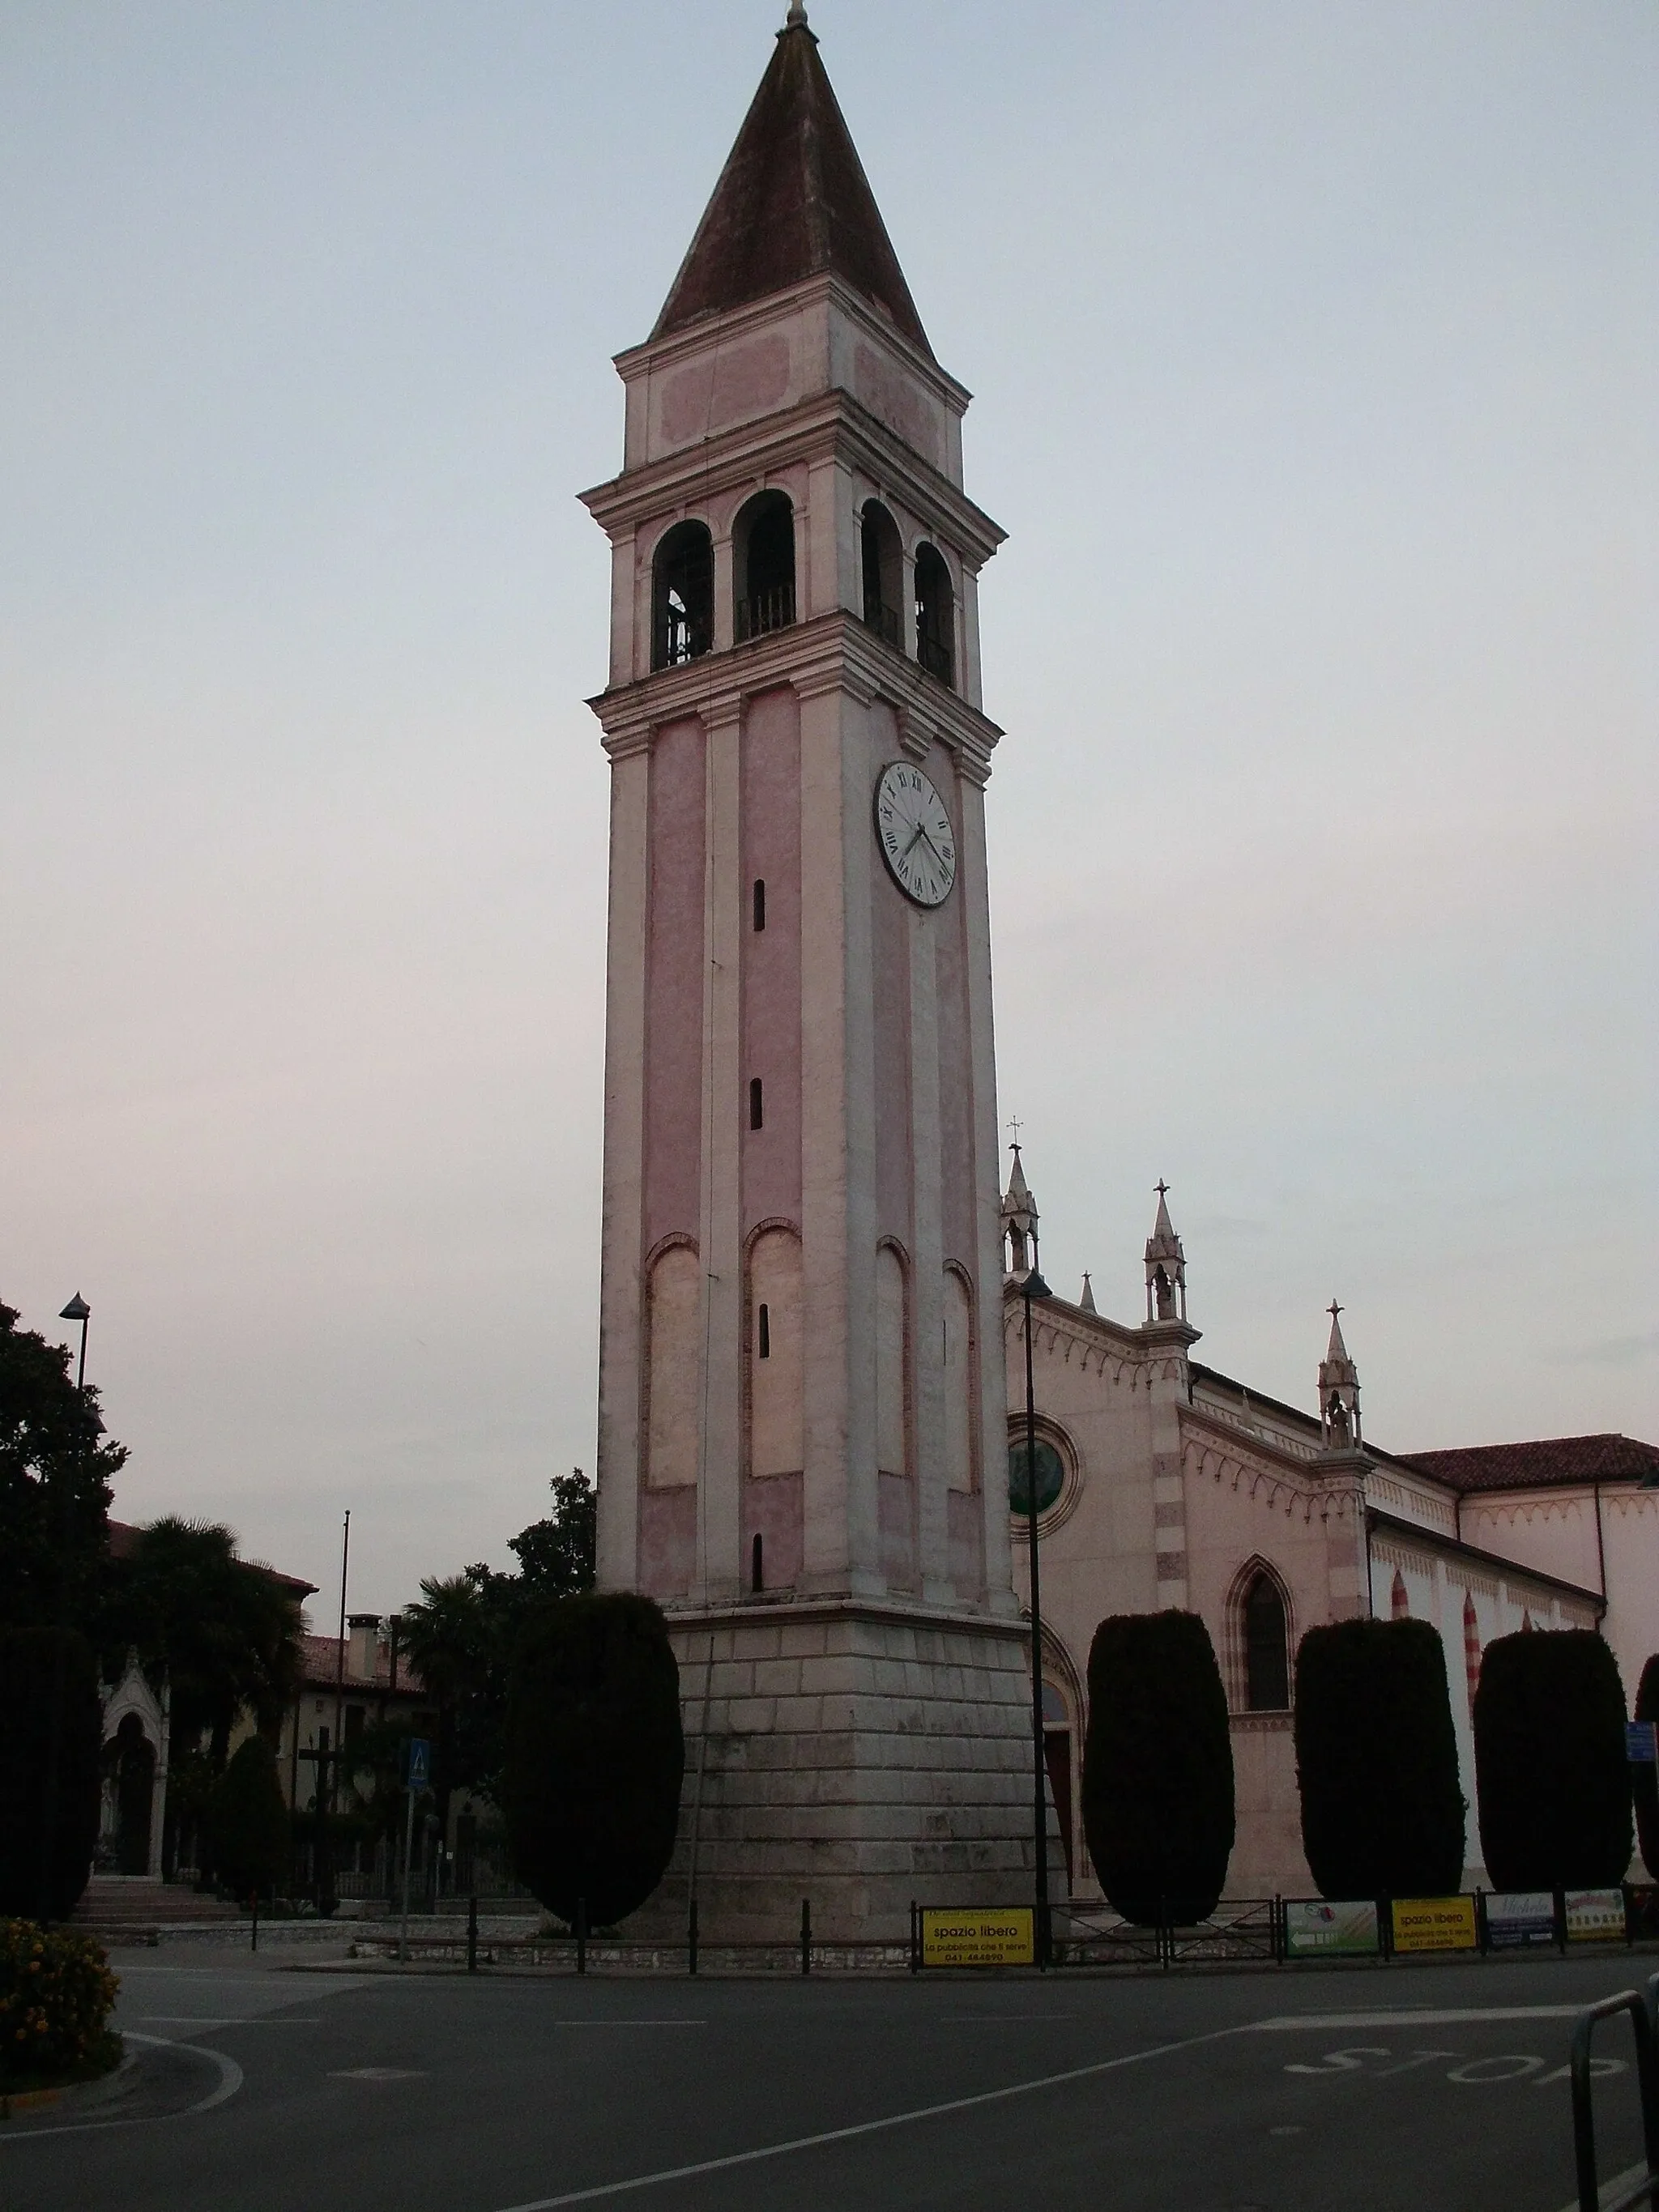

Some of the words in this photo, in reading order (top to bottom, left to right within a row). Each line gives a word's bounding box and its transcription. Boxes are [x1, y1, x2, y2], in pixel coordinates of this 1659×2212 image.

[887, 783, 897, 799] X
[911, 773, 922, 793] XII
[886, 831, 898, 855] VIII
[942, 845, 951, 860] III
[898, 858, 909, 879] VII
[914, 877, 923, 894] VI
[934, 1925, 976, 1939] spazio
[980, 1924, 1017, 1937] libero
[1283, 2047, 1630, 2085] STOP
